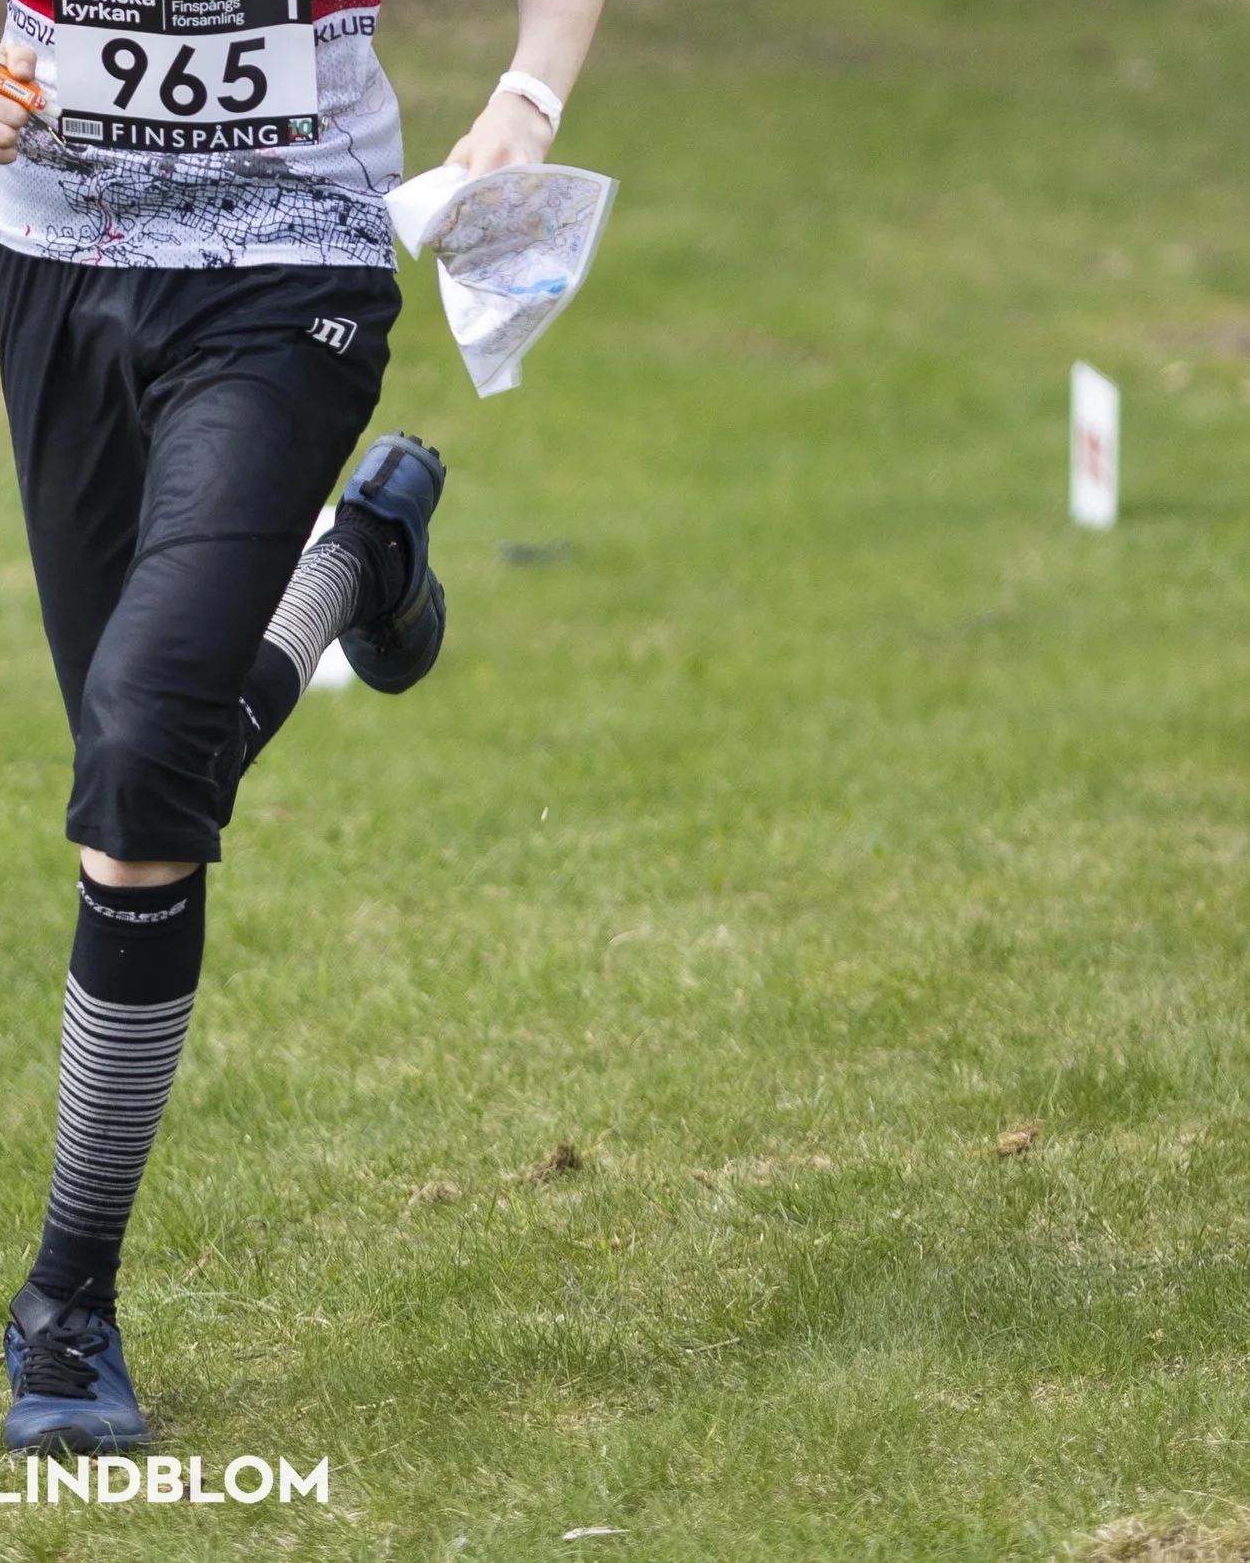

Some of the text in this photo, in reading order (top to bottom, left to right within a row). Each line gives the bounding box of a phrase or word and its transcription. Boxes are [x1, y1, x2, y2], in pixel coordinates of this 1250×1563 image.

[171, 12, 245, 27] församling
[101, 37, 268, 116] 965
[111, 122, 279, 149] FINSPÅNG
